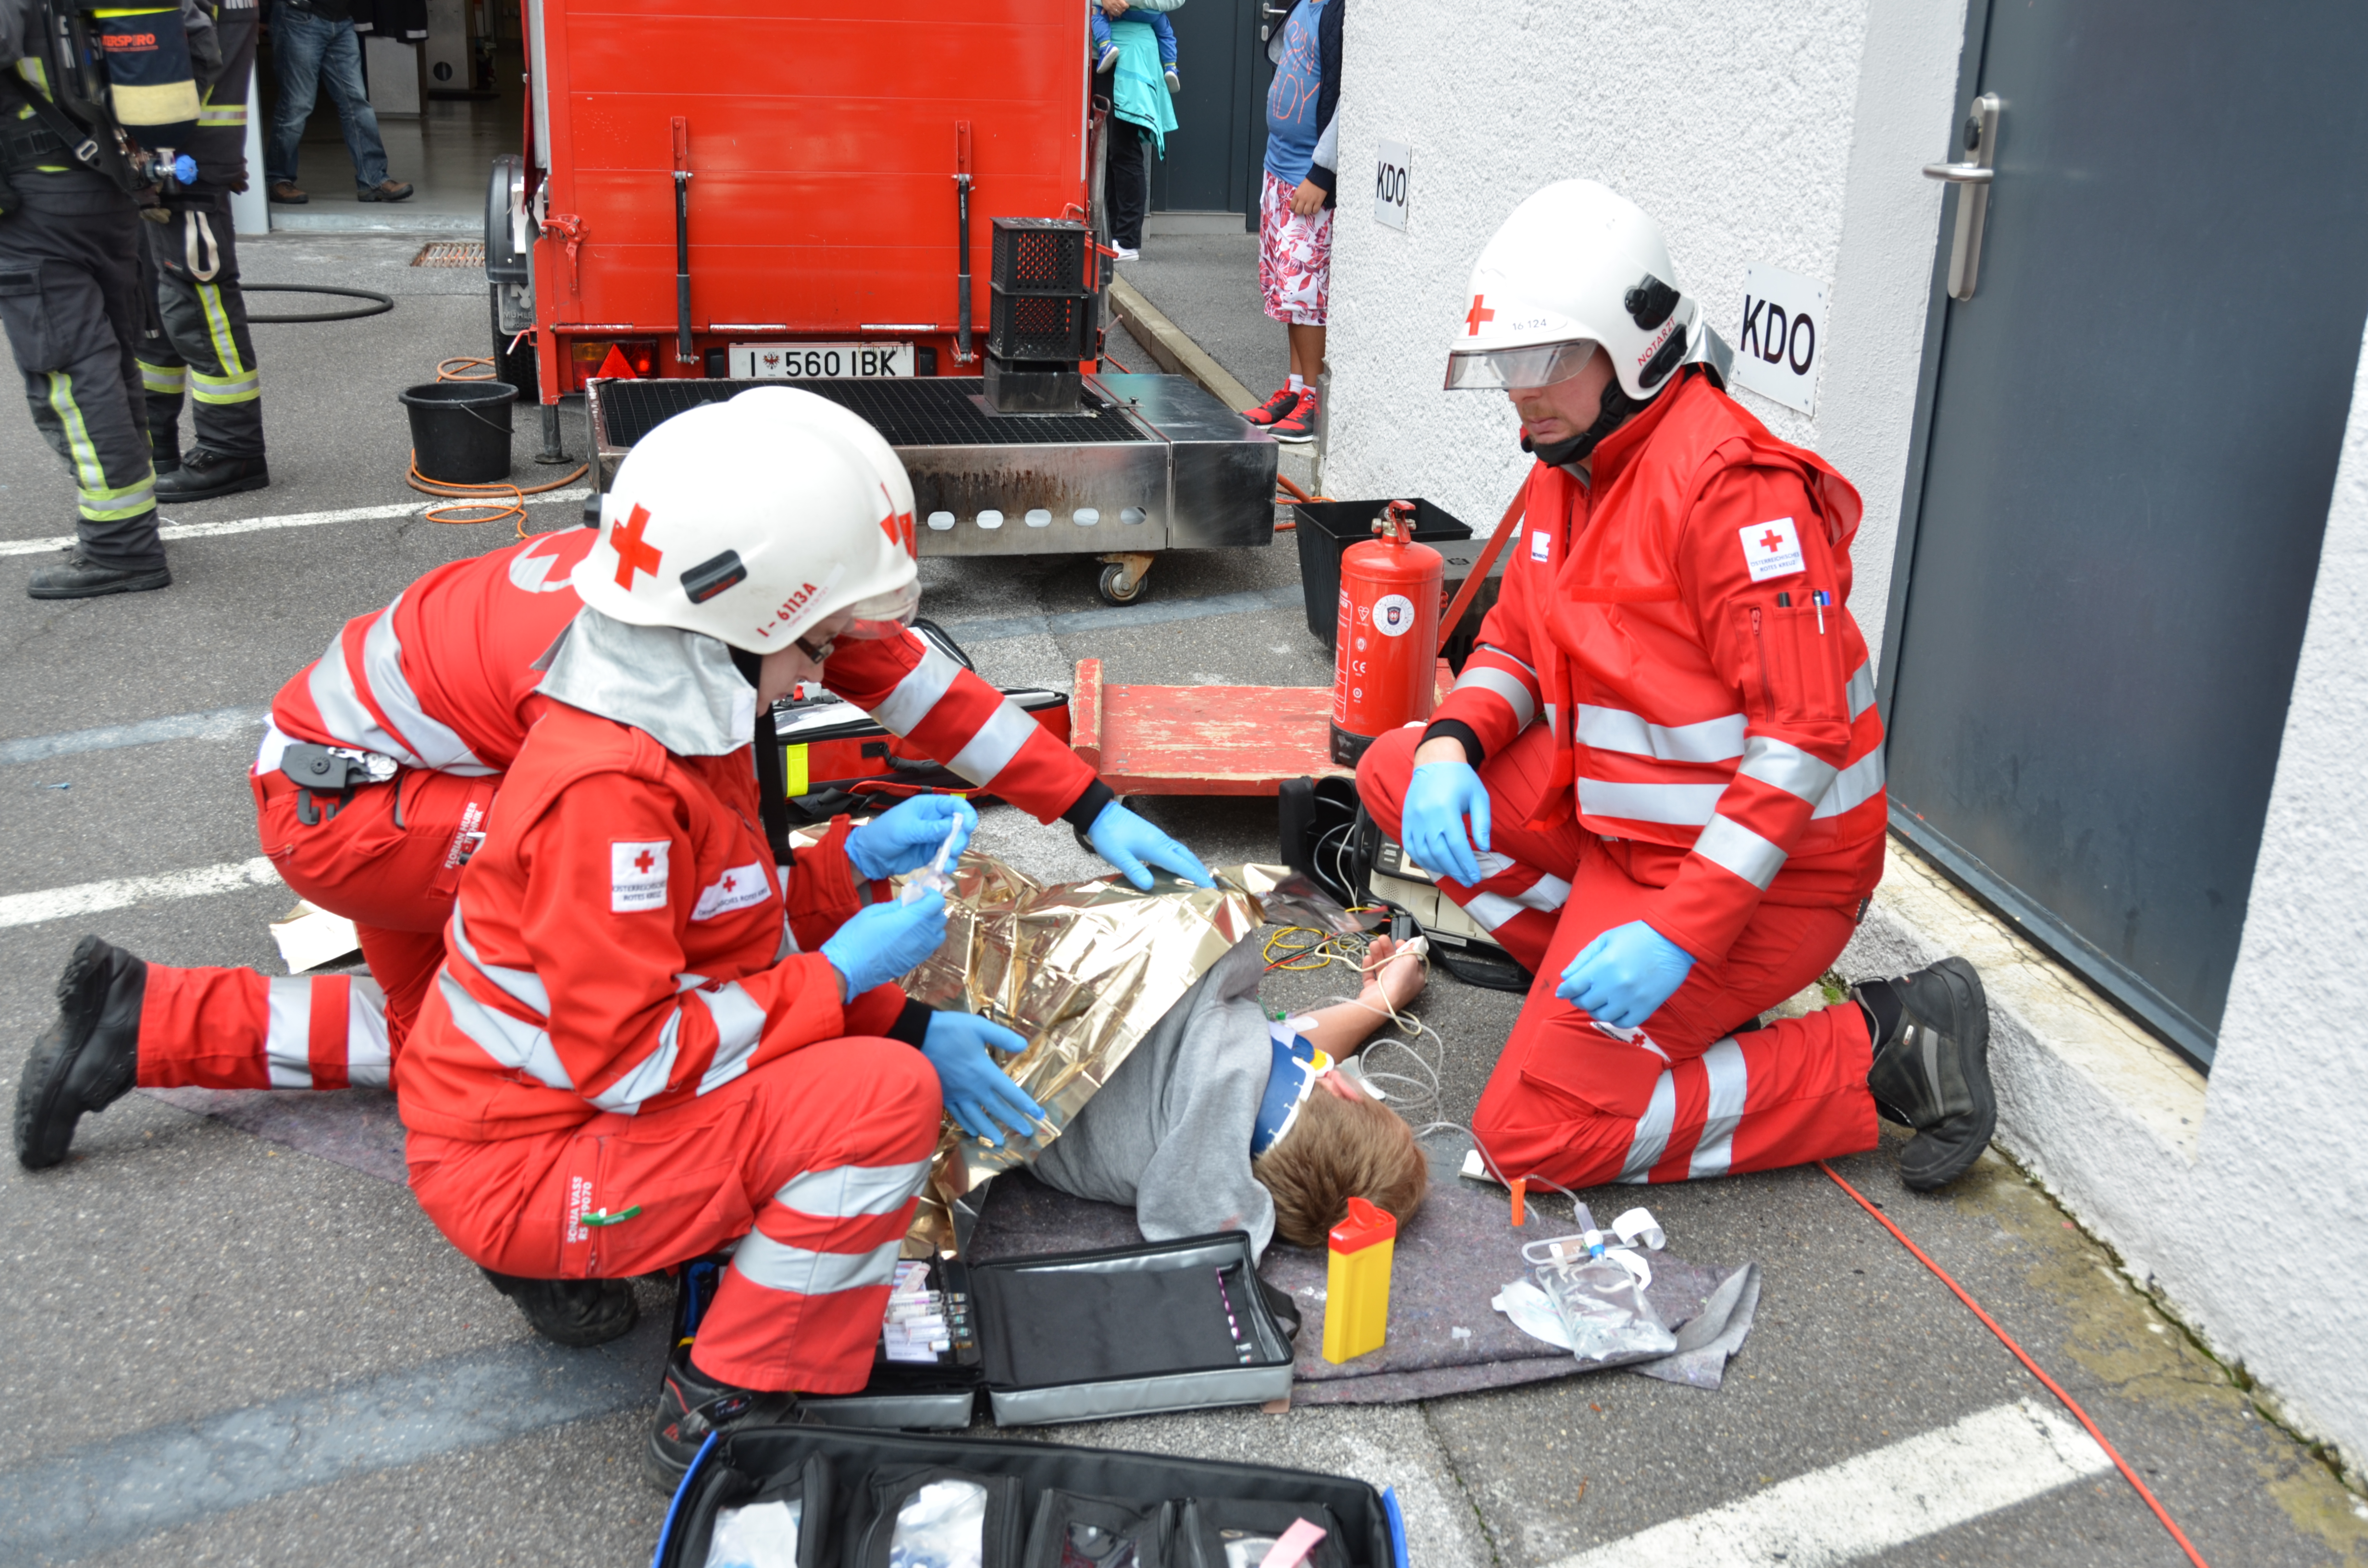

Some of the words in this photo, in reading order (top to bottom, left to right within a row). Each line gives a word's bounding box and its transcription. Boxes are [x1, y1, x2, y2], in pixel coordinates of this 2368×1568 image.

[1377, 161, 1406, 207] KDO
[1513, 322, 1524, 331] 16
[1528, 318, 1546, 329] 124
[1638, 316, 1675, 367] NOTARZT
[1740, 294, 1815, 376] KDO
[751, 352, 755, 377] I
[786, 351, 840, 377] 560
[852, 351, 896, 376] IBK
[1760, 564, 1777, 572] ROTES
[1779, 560, 1796, 568] KREUZ
[777, 582, 818, 621] 6113A
[1352, 660, 1367, 674] CE
[444, 832, 465, 869] FLORIAN
[459, 802, 478, 832] HUBER
[571, 1176, 582, 1207] VASS
[567, 1207, 580, 1244] SONJA
[578, 1226, 589, 1240] RS
